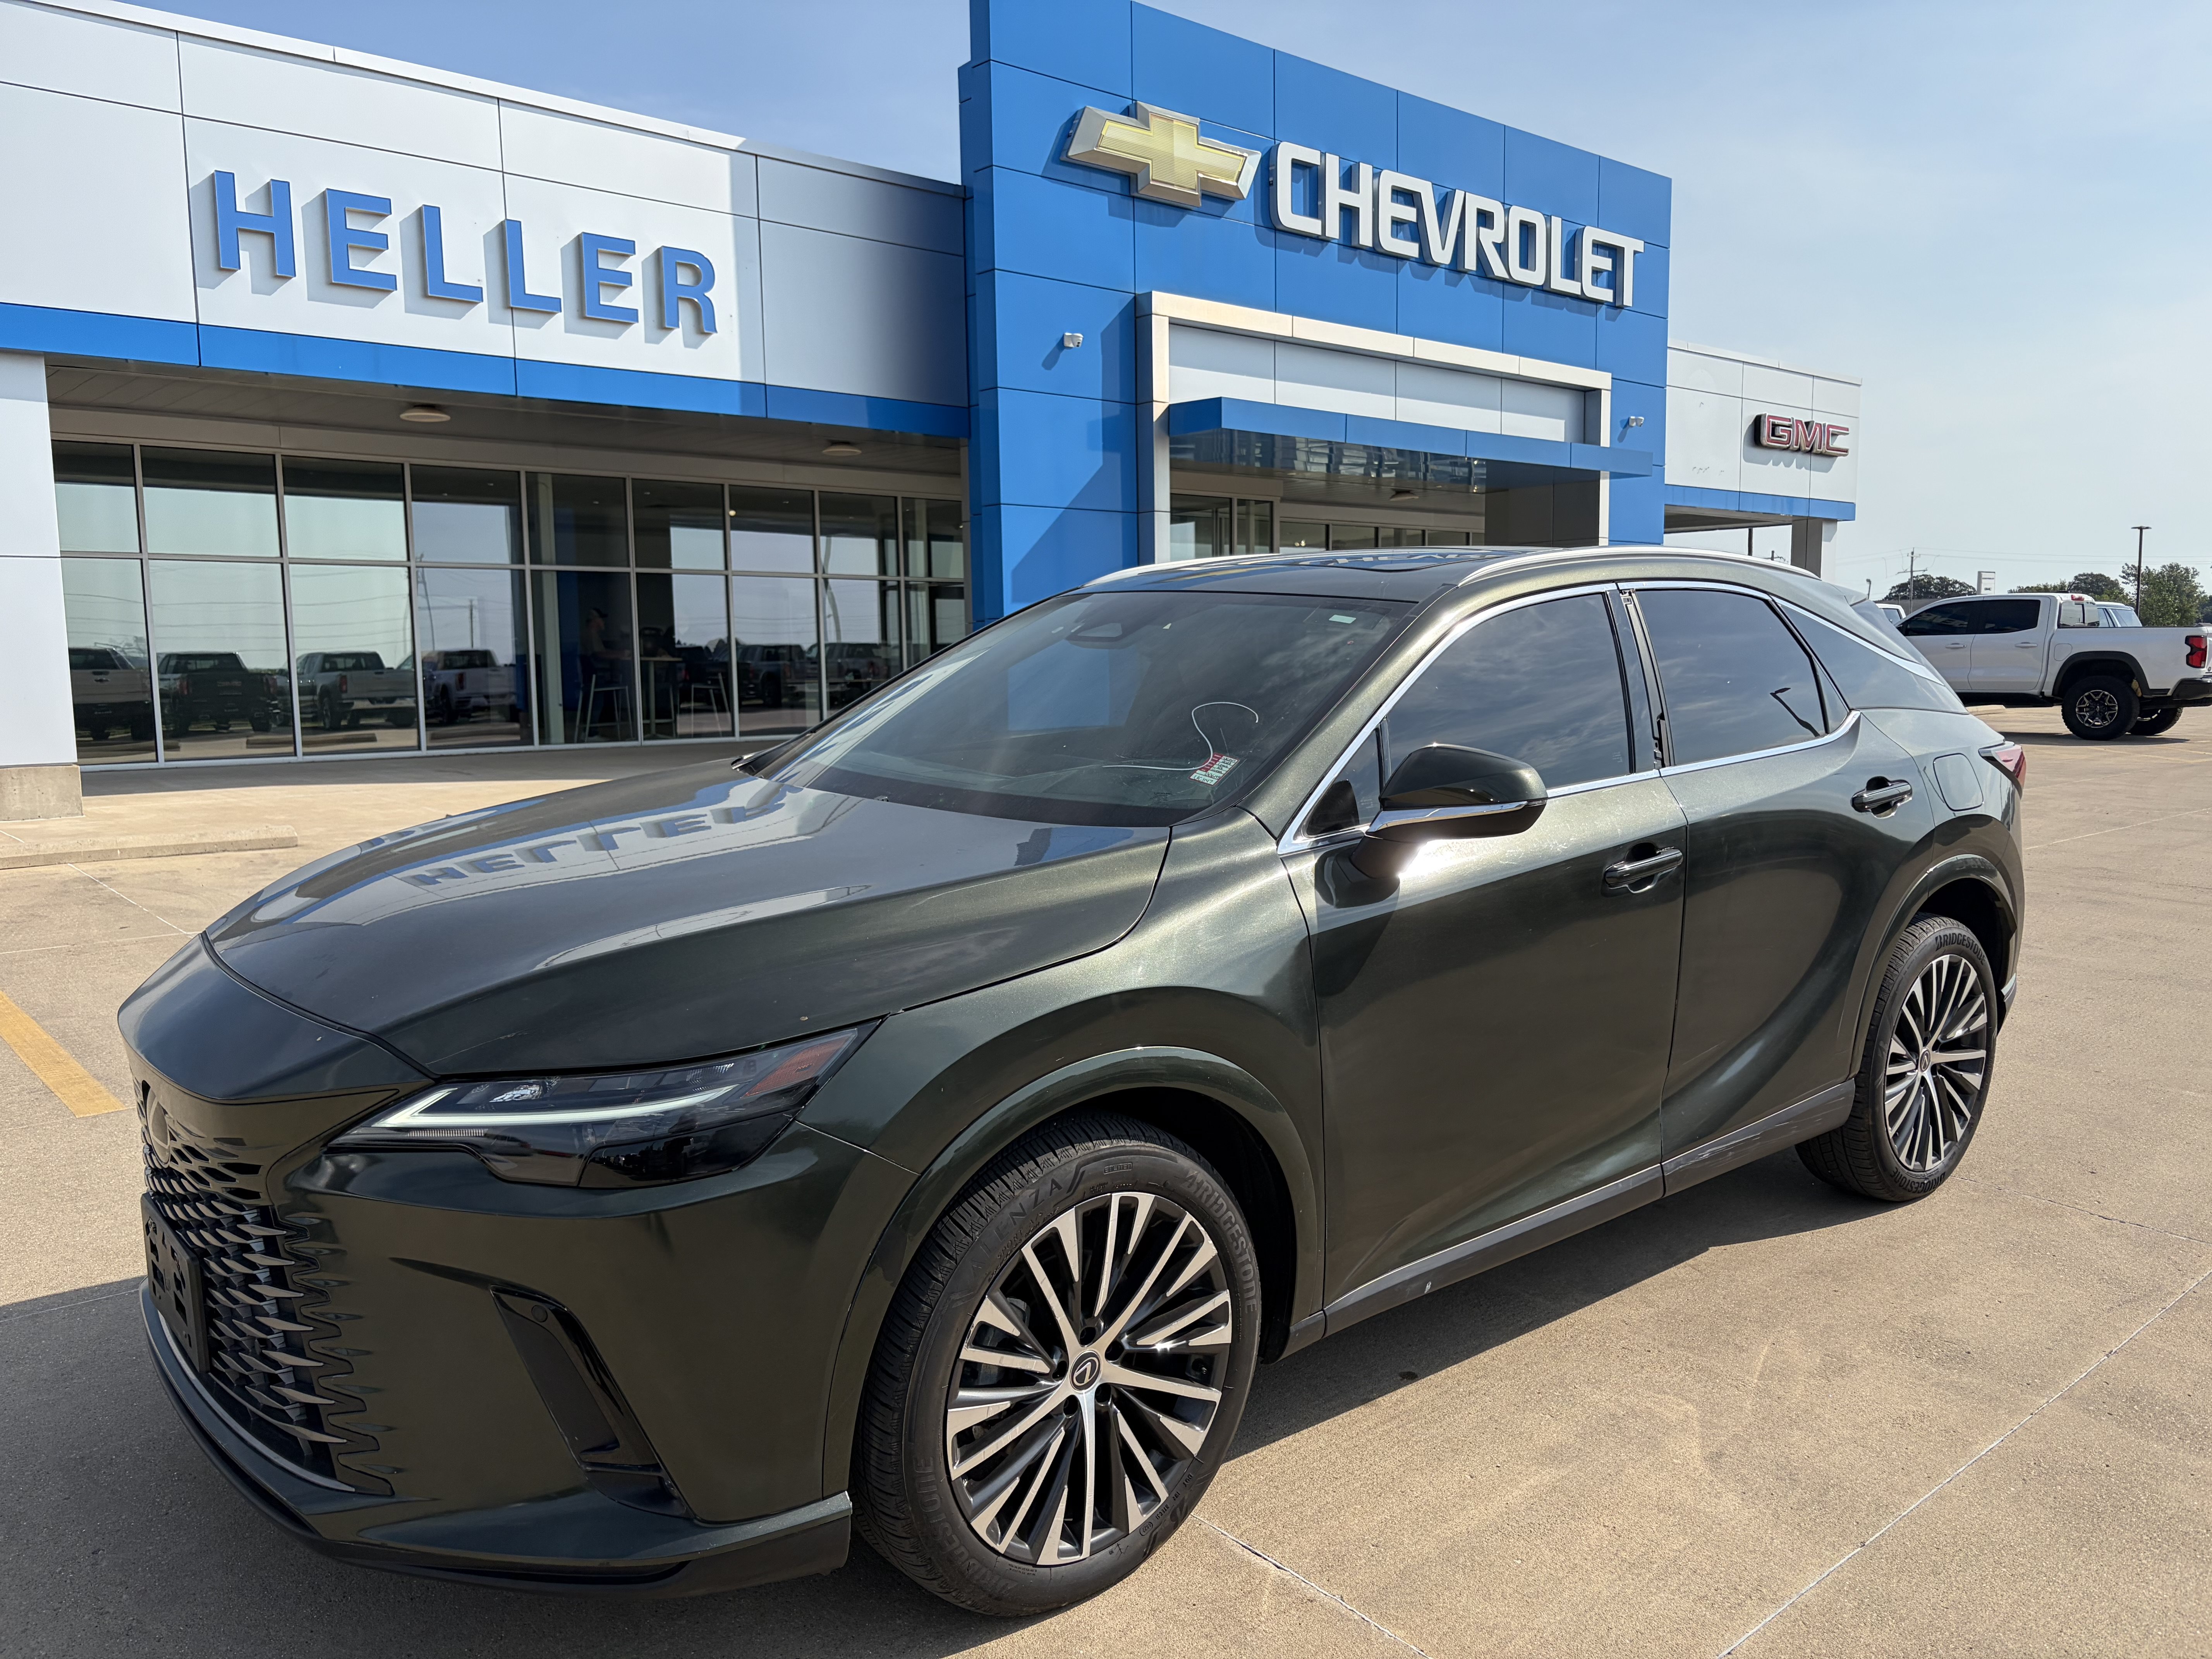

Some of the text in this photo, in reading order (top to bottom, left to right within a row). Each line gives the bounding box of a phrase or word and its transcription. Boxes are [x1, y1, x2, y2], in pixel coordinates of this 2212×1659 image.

[214, 169, 718, 334] HELLER
[1272, 141, 1644, 307] CHEVROLET
[1761, 413, 1850, 457] GMC
[1935, 933, 1986, 965] BRIDGESTONE
[1180, 1168, 1257, 1314] BRIDGESTONE
